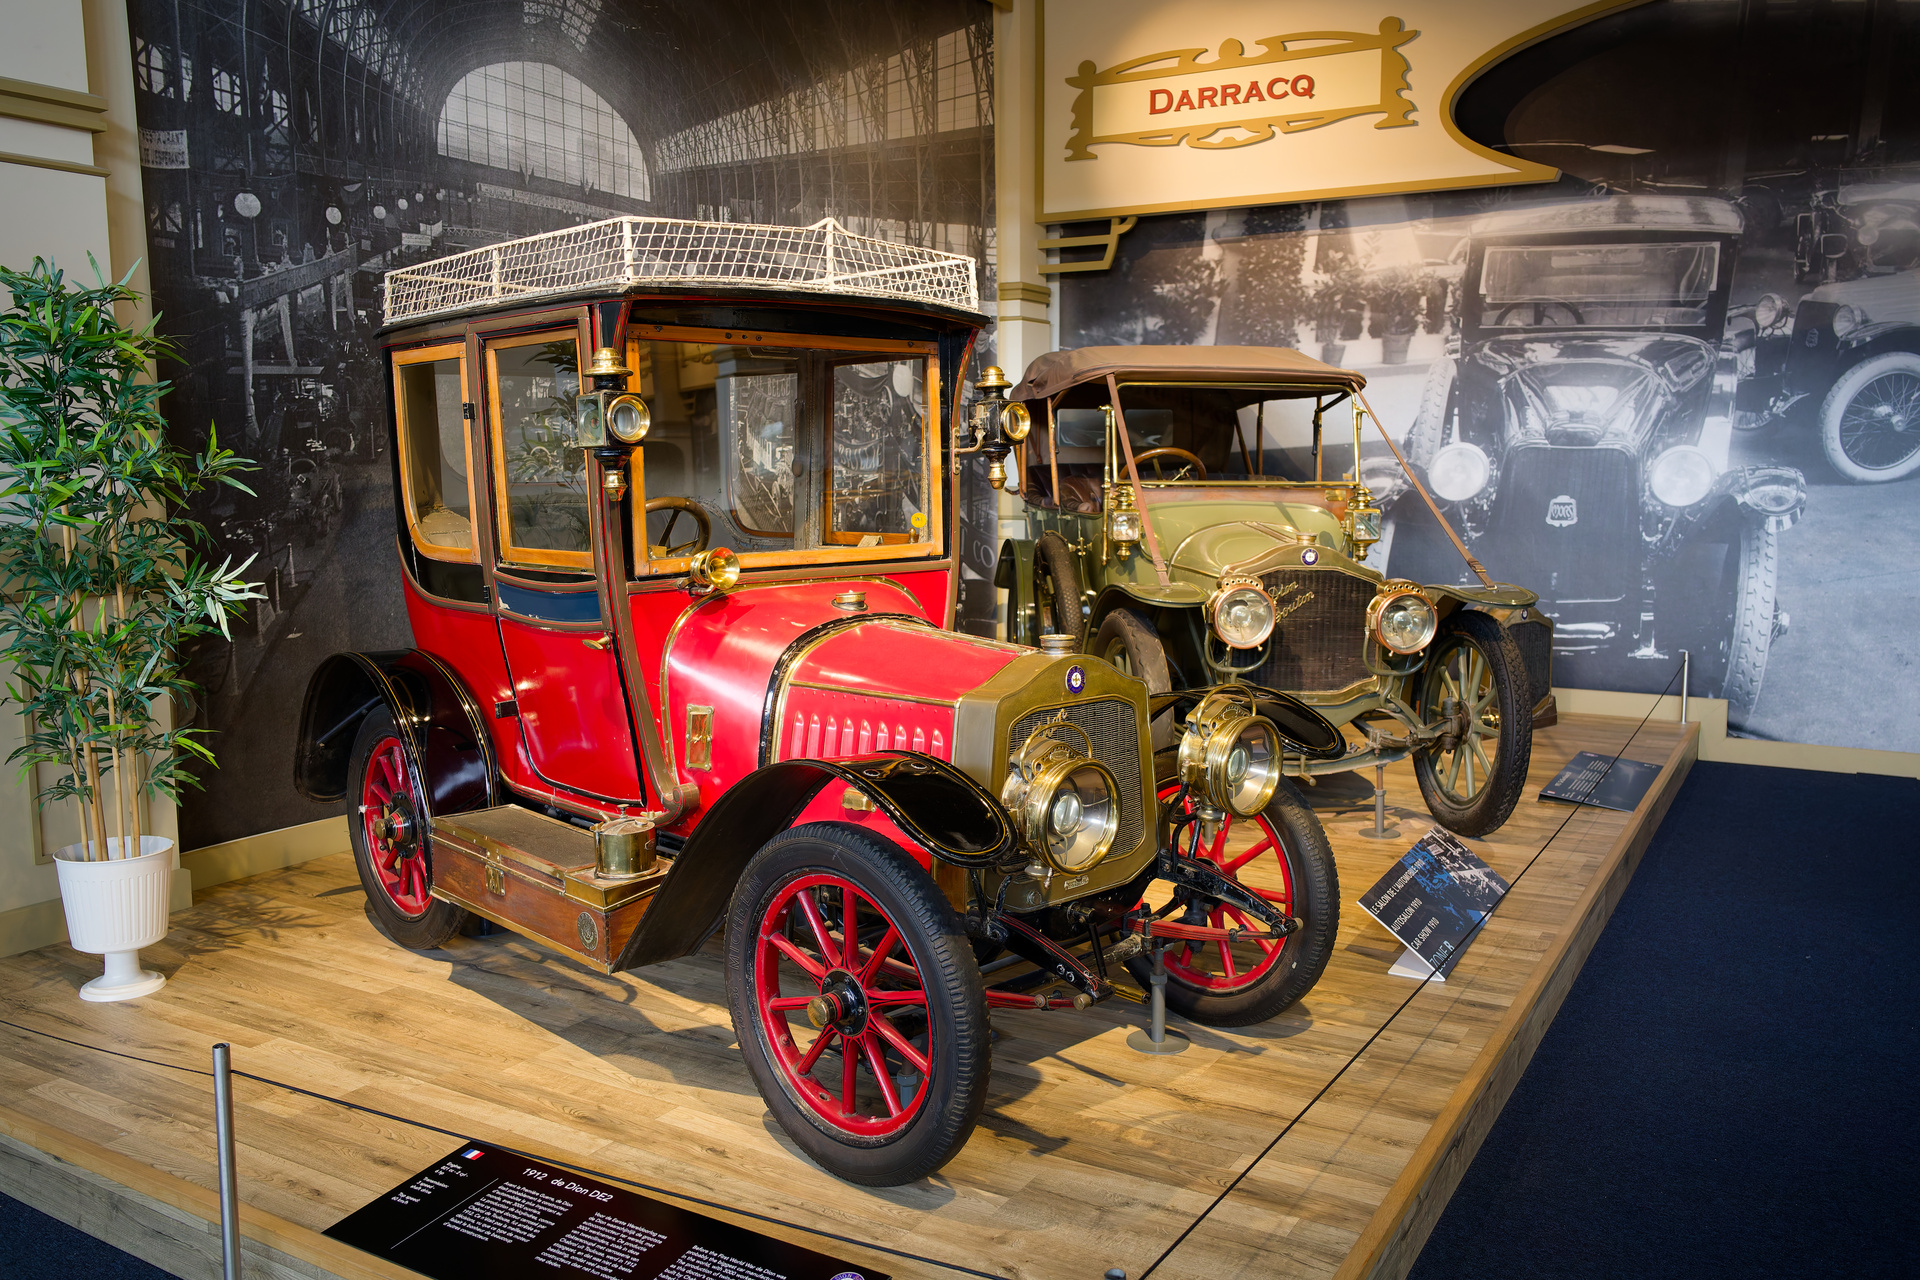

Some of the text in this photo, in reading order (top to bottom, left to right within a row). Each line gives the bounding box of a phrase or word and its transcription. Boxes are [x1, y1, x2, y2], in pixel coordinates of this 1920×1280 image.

[1149, 74, 1315, 115] DARRACQ
[1369, 905, 1380, 915] LE
[1375, 893, 1392, 911] SALON
[1386, 888, 1397, 898] DE
[1390, 897, 1423, 933] AUTOSALON 1910
[728, 873, 764, 971] MICHELIN
[1410, 916, 1440, 950] CAR SHOW 1910
[522, 1168, 613, 1202] 1912 de Dion DE2
